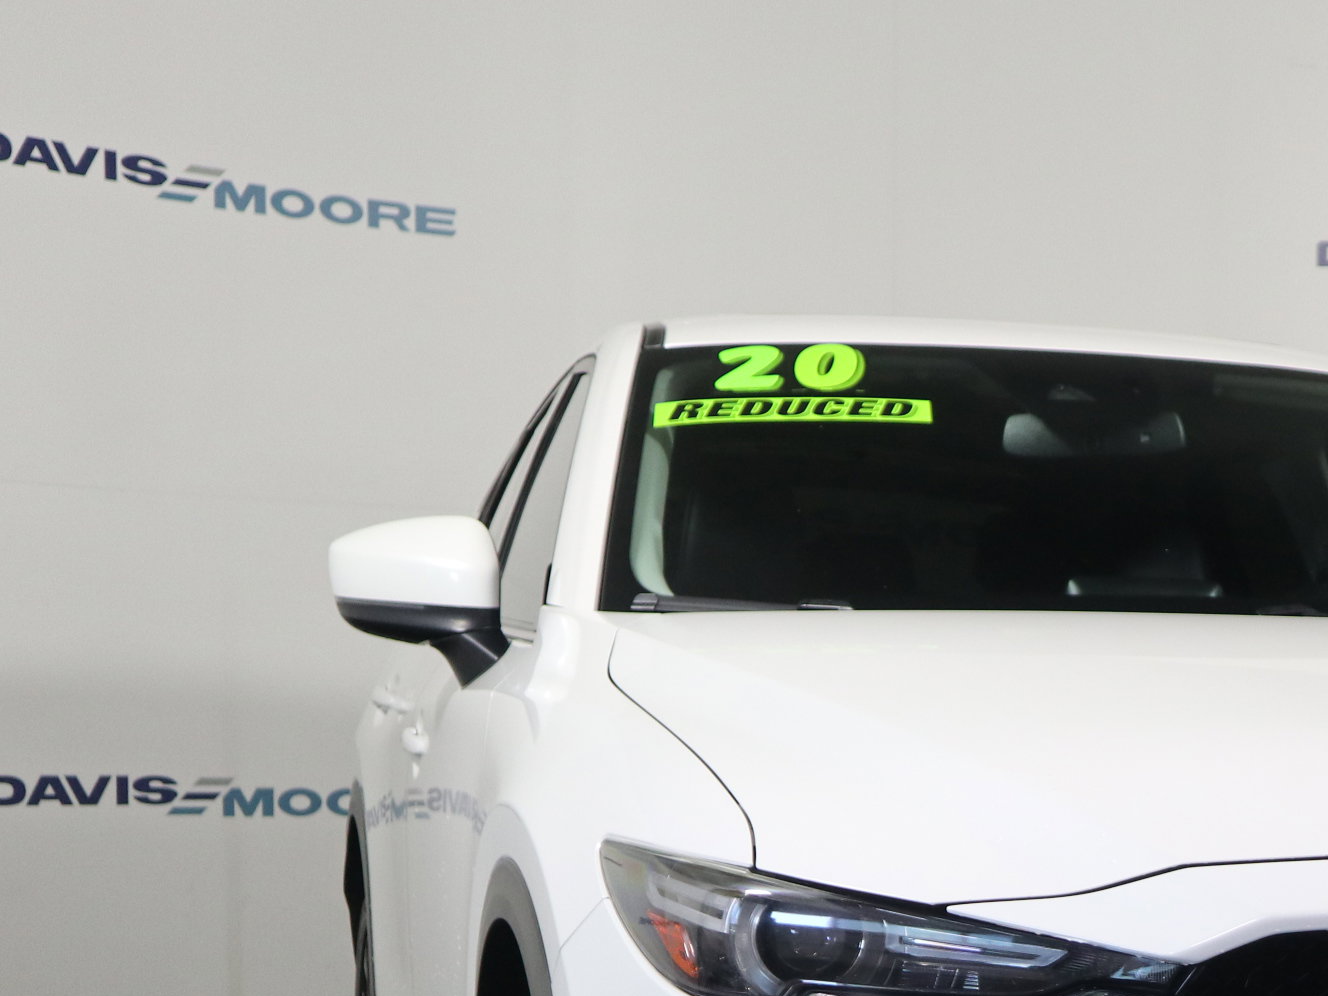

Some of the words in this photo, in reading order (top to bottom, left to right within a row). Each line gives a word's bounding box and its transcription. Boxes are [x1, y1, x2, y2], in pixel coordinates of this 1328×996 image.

[214, 179, 457, 237] MOORE
[714, 343, 866, 392] 20
[668, 398, 918, 421] REDUCED
[222, 787, 351, 818] MOO
